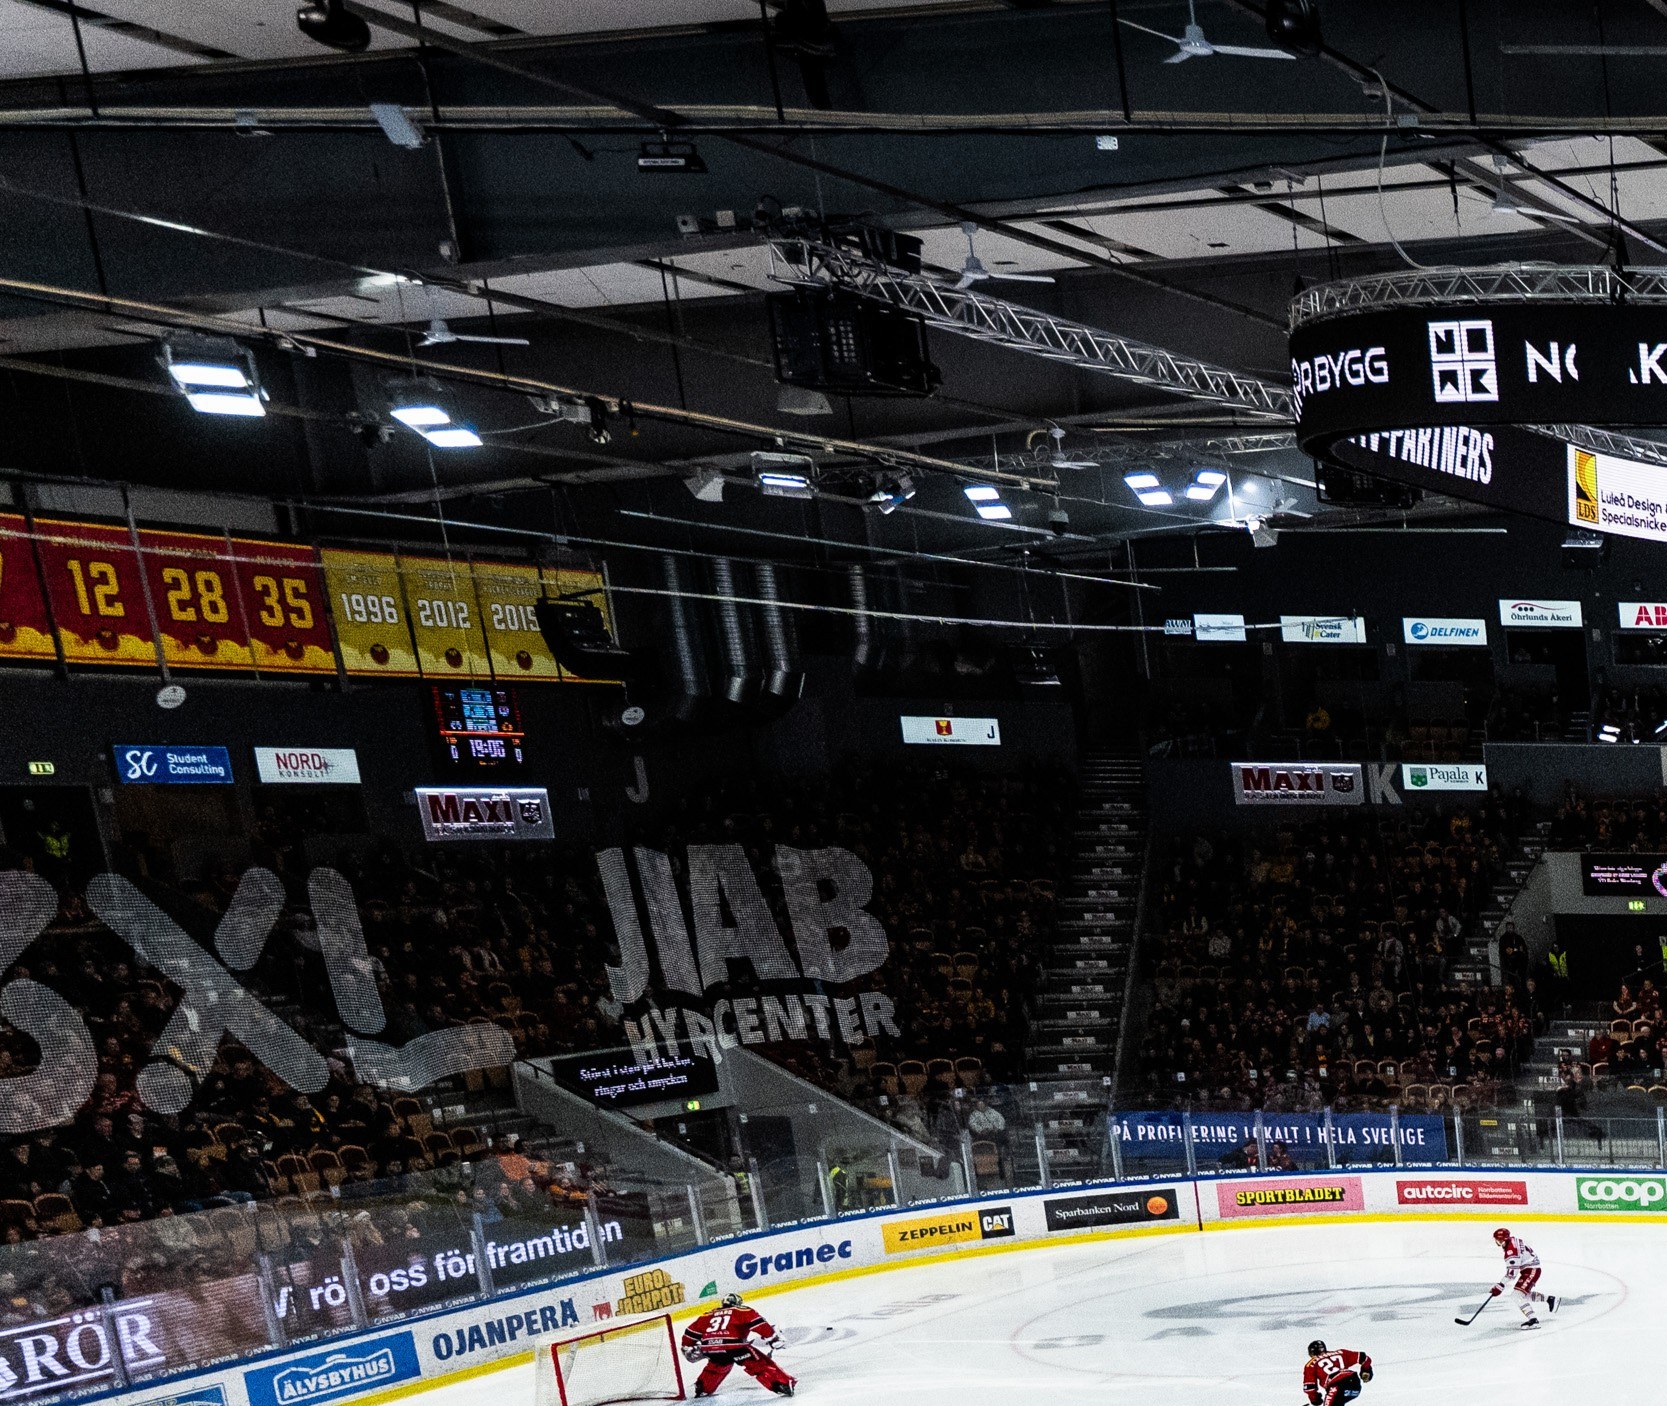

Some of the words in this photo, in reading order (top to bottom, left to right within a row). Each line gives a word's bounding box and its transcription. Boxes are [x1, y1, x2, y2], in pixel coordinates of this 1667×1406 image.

[1577, 503, 1597, 520] LDS
[1601, 492, 1626, 507] Luleå
[1627, 495, 1662, 515] Design
[67, 559, 125, 617] 12
[162, 567, 230, 623] 28
[252, 575, 314, 629] 35
[341, 593, 399, 624] 1996
[417, 599, 471, 628] 2012
[1430, 627, 1480, 638] DELFINEN
[986, 726, 995, 739] J
[166, 753, 208, 763] Student
[275, 752, 323, 770] NORD
[169, 764, 225, 777] Consulting
[1429, 766, 1469, 782] Pajala
[1475, 771, 1484, 784] K
[1236, 1186, 1345, 1206] SPORTBLADET
[1404, 1184, 1474, 1199] autocirc
[1580, 1181, 1664, 1206] coop
[1055, 1204, 1111, 1220] Sparbanken
[1115, 1201, 1139, 1214] Nord
[899, 1222, 973, 1242] ZEPPELIN
[982, 1213, 1010, 1232] CAT
[735, 1239, 852, 1280] Granec
[370, 1267, 426, 1296] oss
[434, 1248, 475, 1279] för
[624, 1269, 671, 1296] EURO
[616, 1282, 685, 1316] JACKPOT
[706, 1315, 731, 1333] 31
[1322, 1355, 1345, 1375] 27
[283, 1357, 389, 1400] ÄLVSBYHUS
